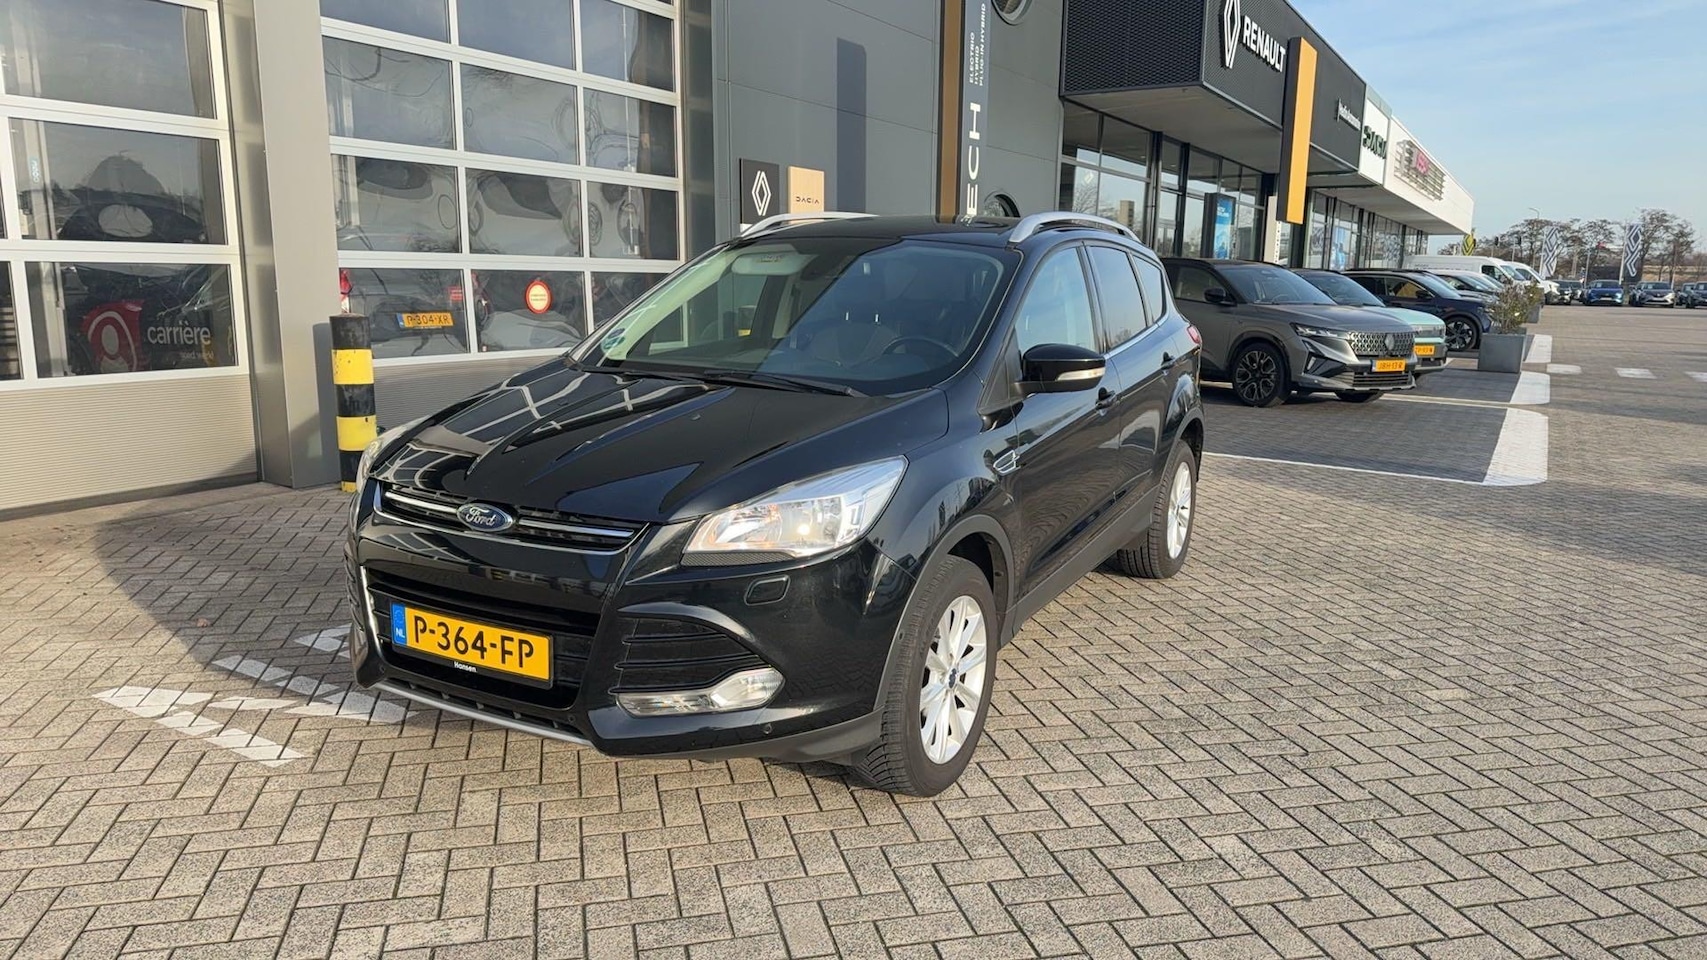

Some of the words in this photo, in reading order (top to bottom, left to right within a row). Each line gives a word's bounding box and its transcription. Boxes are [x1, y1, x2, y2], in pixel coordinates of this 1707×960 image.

[1243, 15, 1286, 72] RENAULT
[966, 102, 981, 216] ECH
[795, 196, 820, 204] DACIA
[406, 313, 450, 325] P-304-XR
[147, 320, 211, 345] carrière
[465, 506, 497, 526] Ford
[395, 628, 405, 638] NL
[414, 615, 533, 668] P-364-FP
